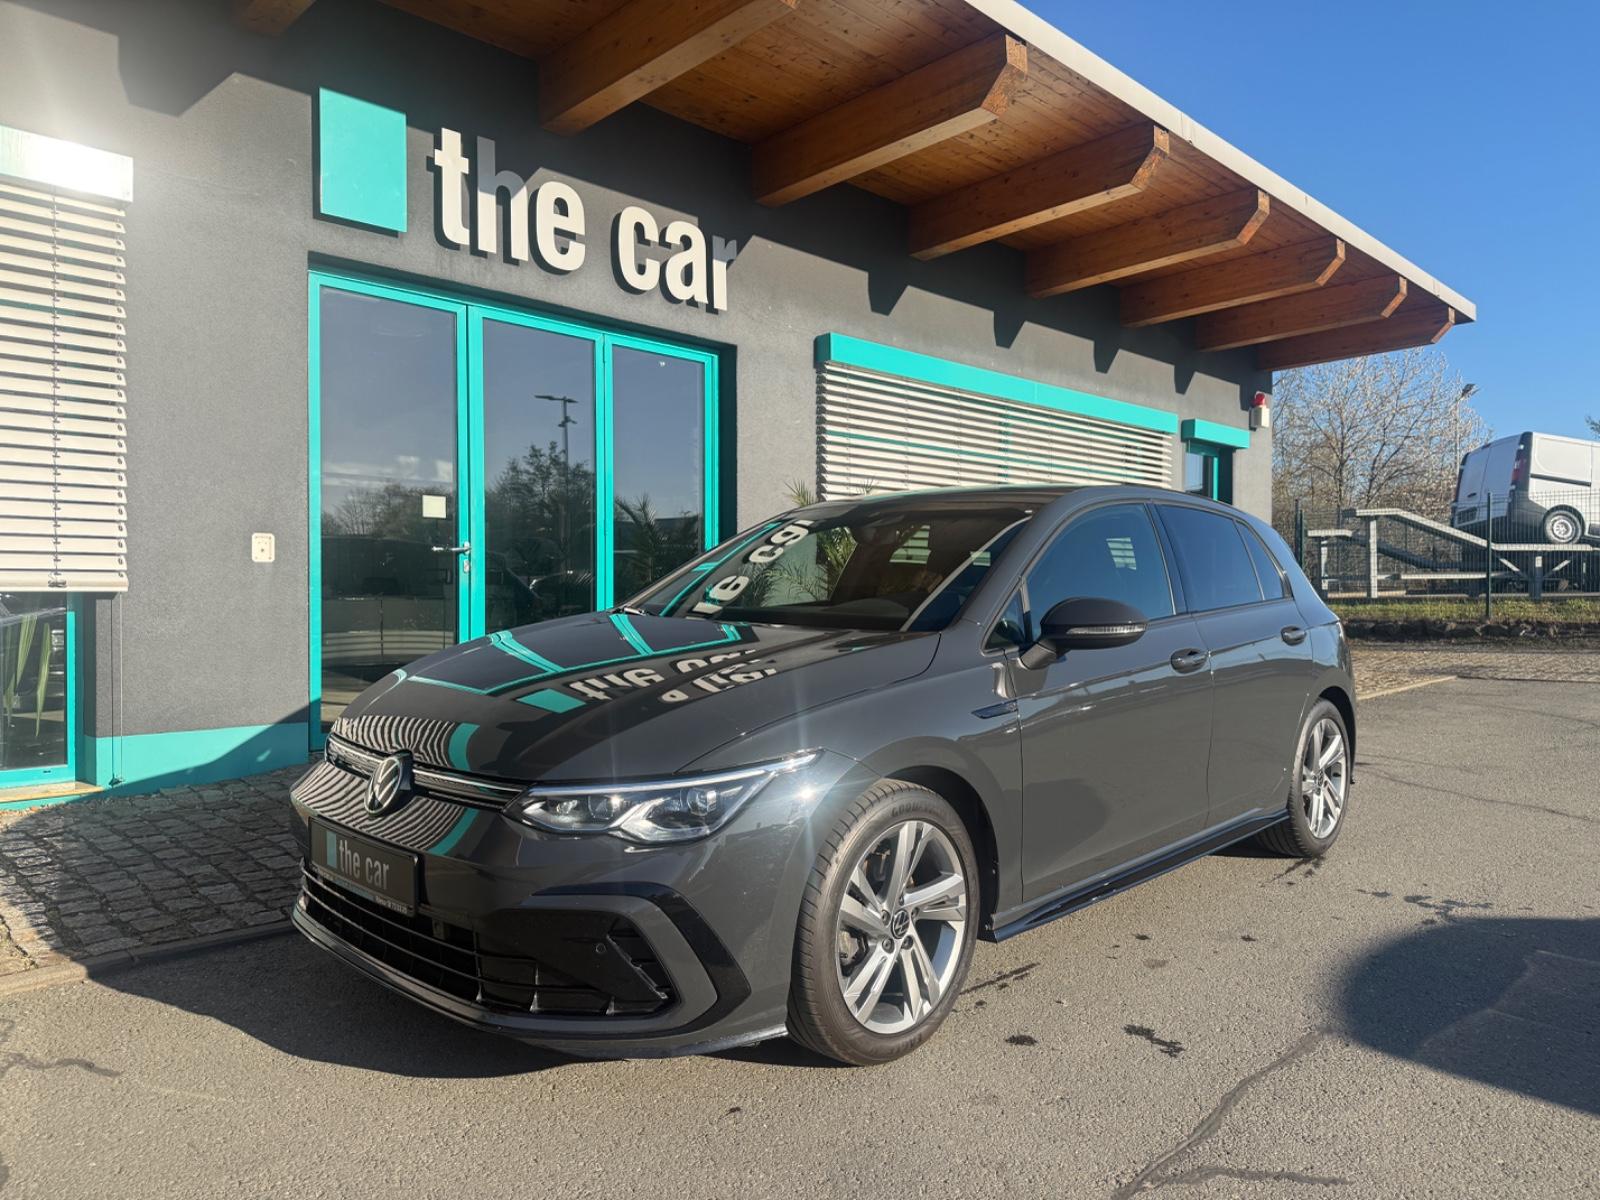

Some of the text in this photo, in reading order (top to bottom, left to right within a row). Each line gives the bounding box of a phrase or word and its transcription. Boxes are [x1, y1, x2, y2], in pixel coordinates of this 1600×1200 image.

[434, 127, 737, 311] the car
[339, 839, 360, 879] the
[365, 856, 390, 890] car
